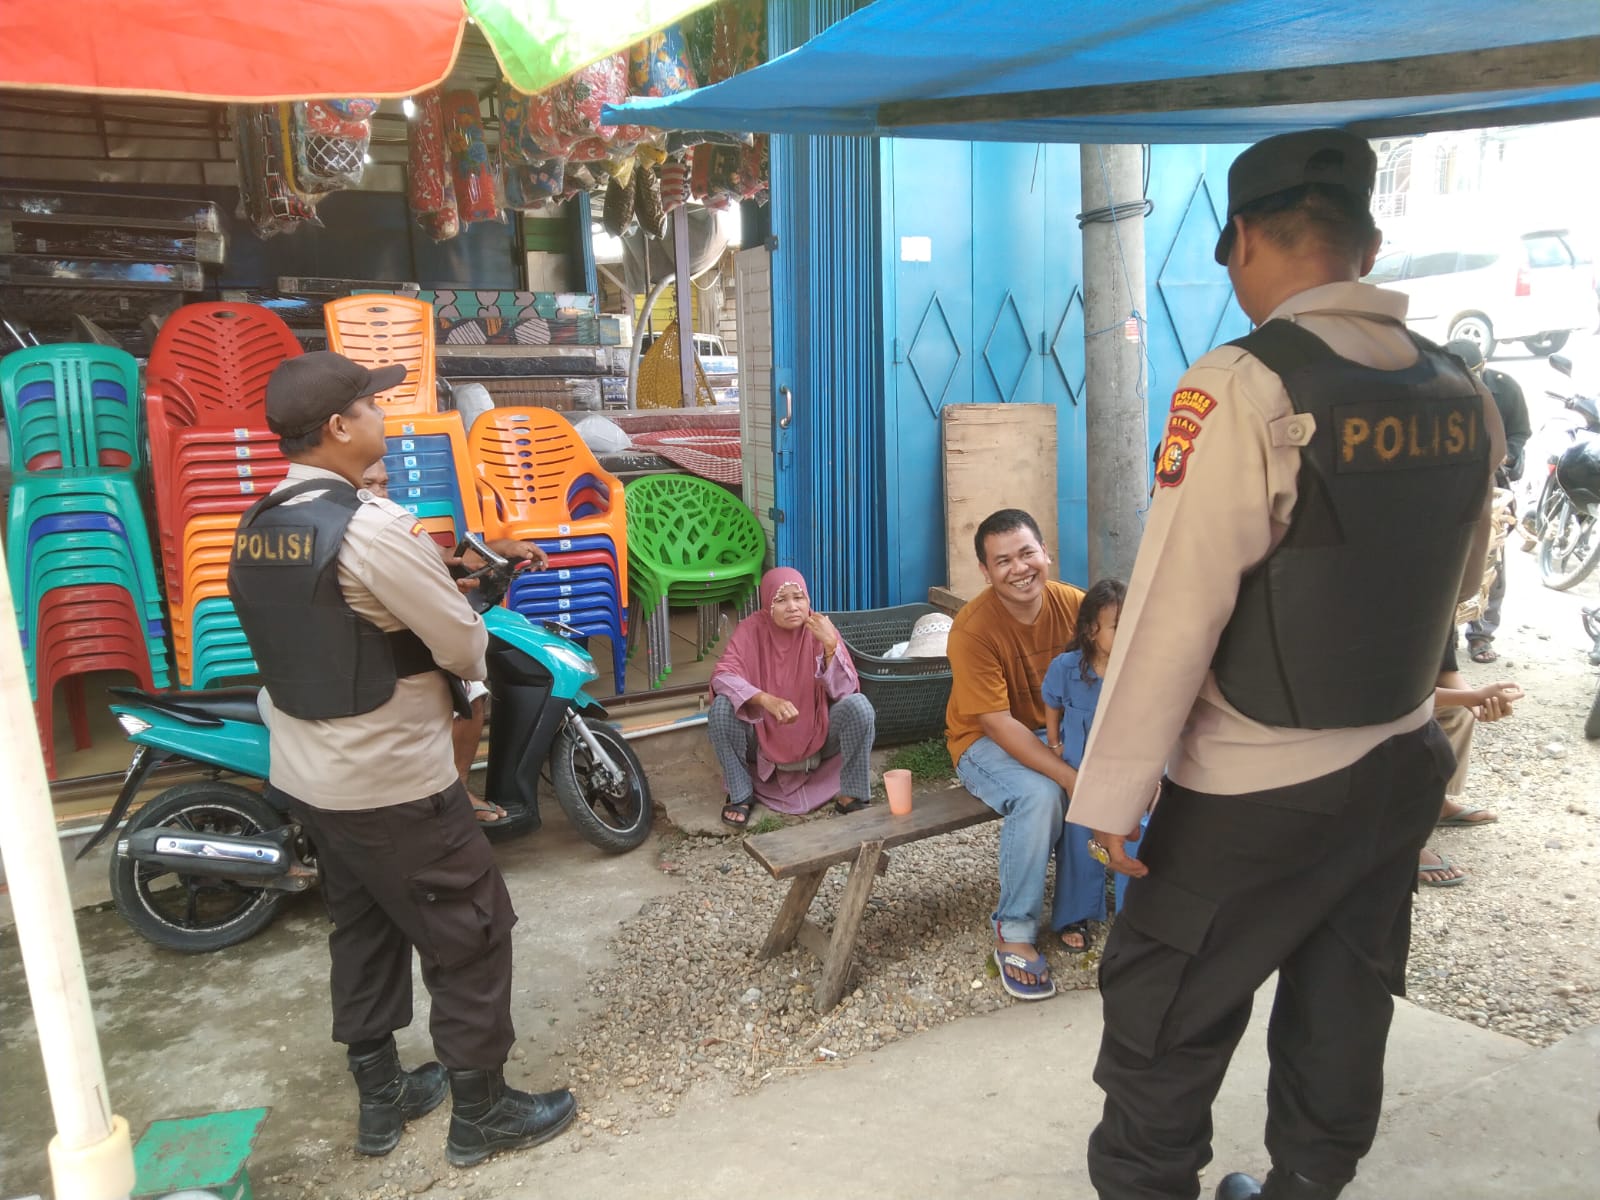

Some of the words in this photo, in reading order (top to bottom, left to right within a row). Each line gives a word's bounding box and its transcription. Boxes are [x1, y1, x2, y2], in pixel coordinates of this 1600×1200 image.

[1174, 391, 1211, 408] POLRES
[1171, 417, 1197, 432] RIAU
[1342, 409, 1477, 463] POLISI
[236, 533, 312, 560] POLISI
